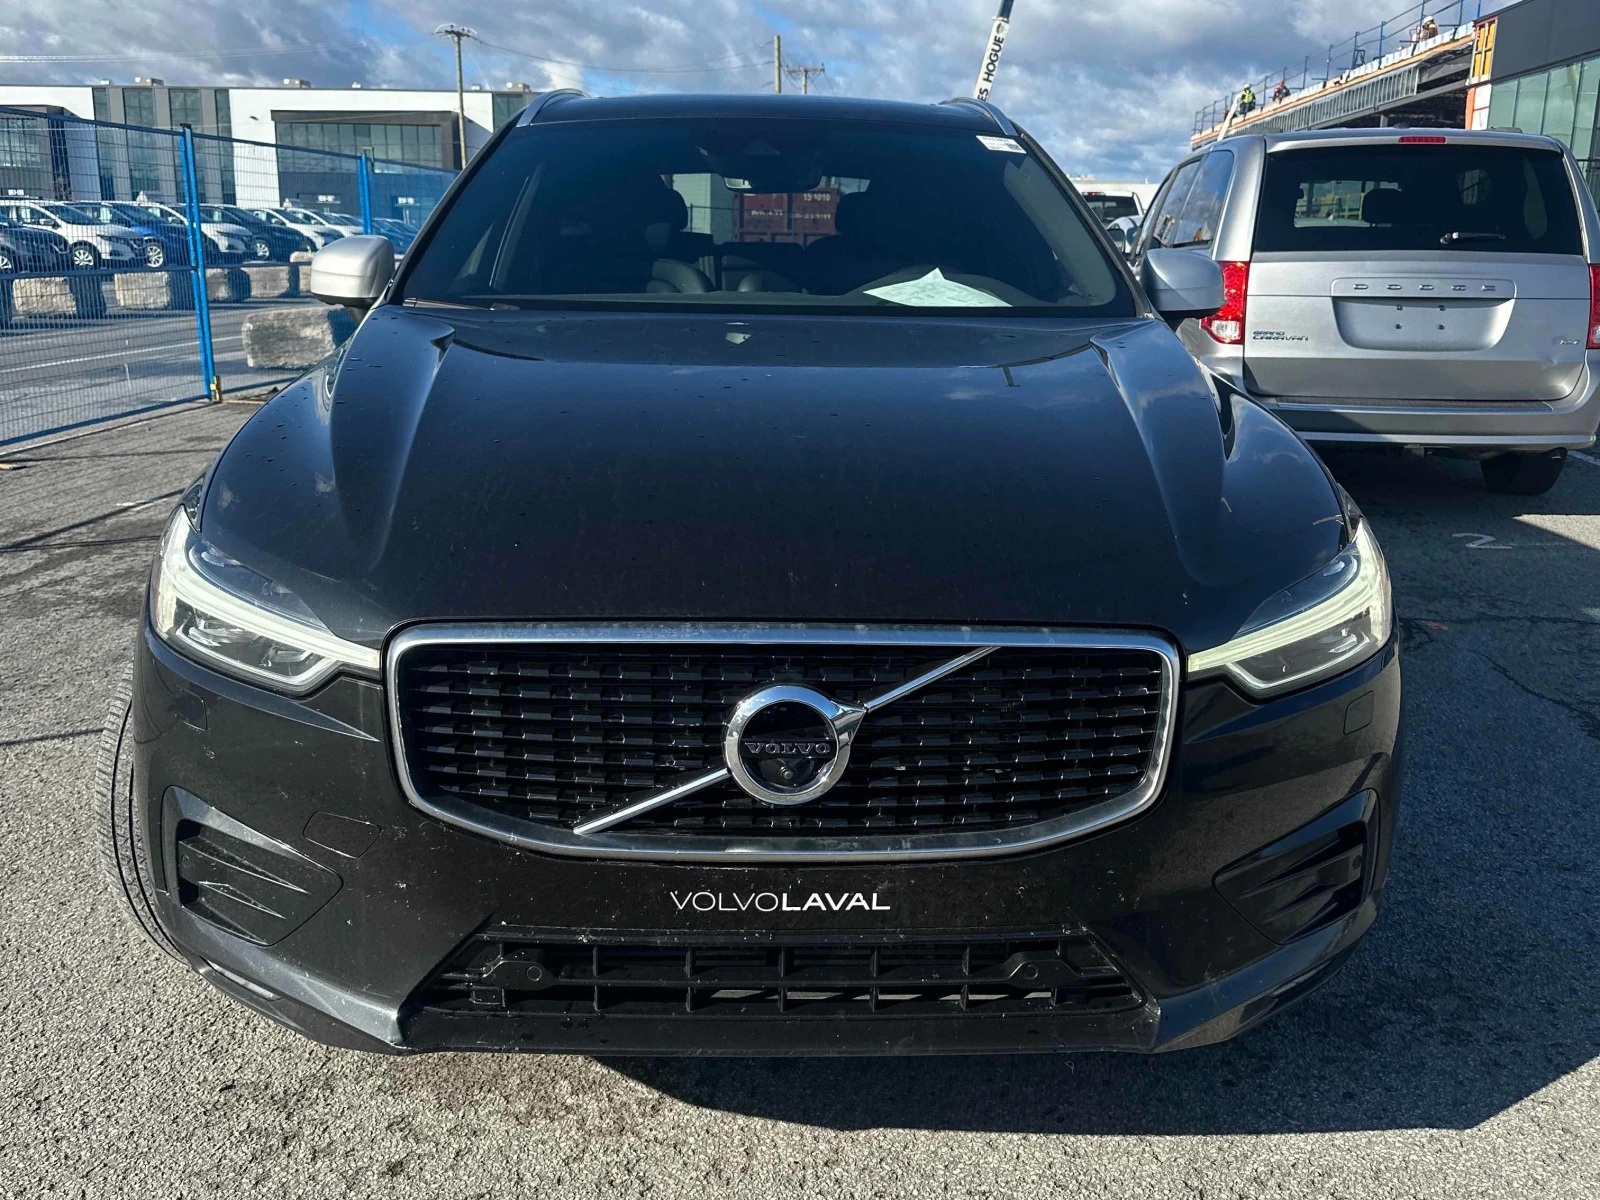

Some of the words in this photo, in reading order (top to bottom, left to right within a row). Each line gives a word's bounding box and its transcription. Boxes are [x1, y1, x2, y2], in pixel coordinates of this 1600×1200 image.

[982, 35, 1005, 83] HOGUE
[1353, 283, 1496, 292] DODGE
[1451, 532, 1513, 550] 2
[744, 742, 831, 754] VOLVO
[669, 892, 891, 911] VOLVOLAVAL
